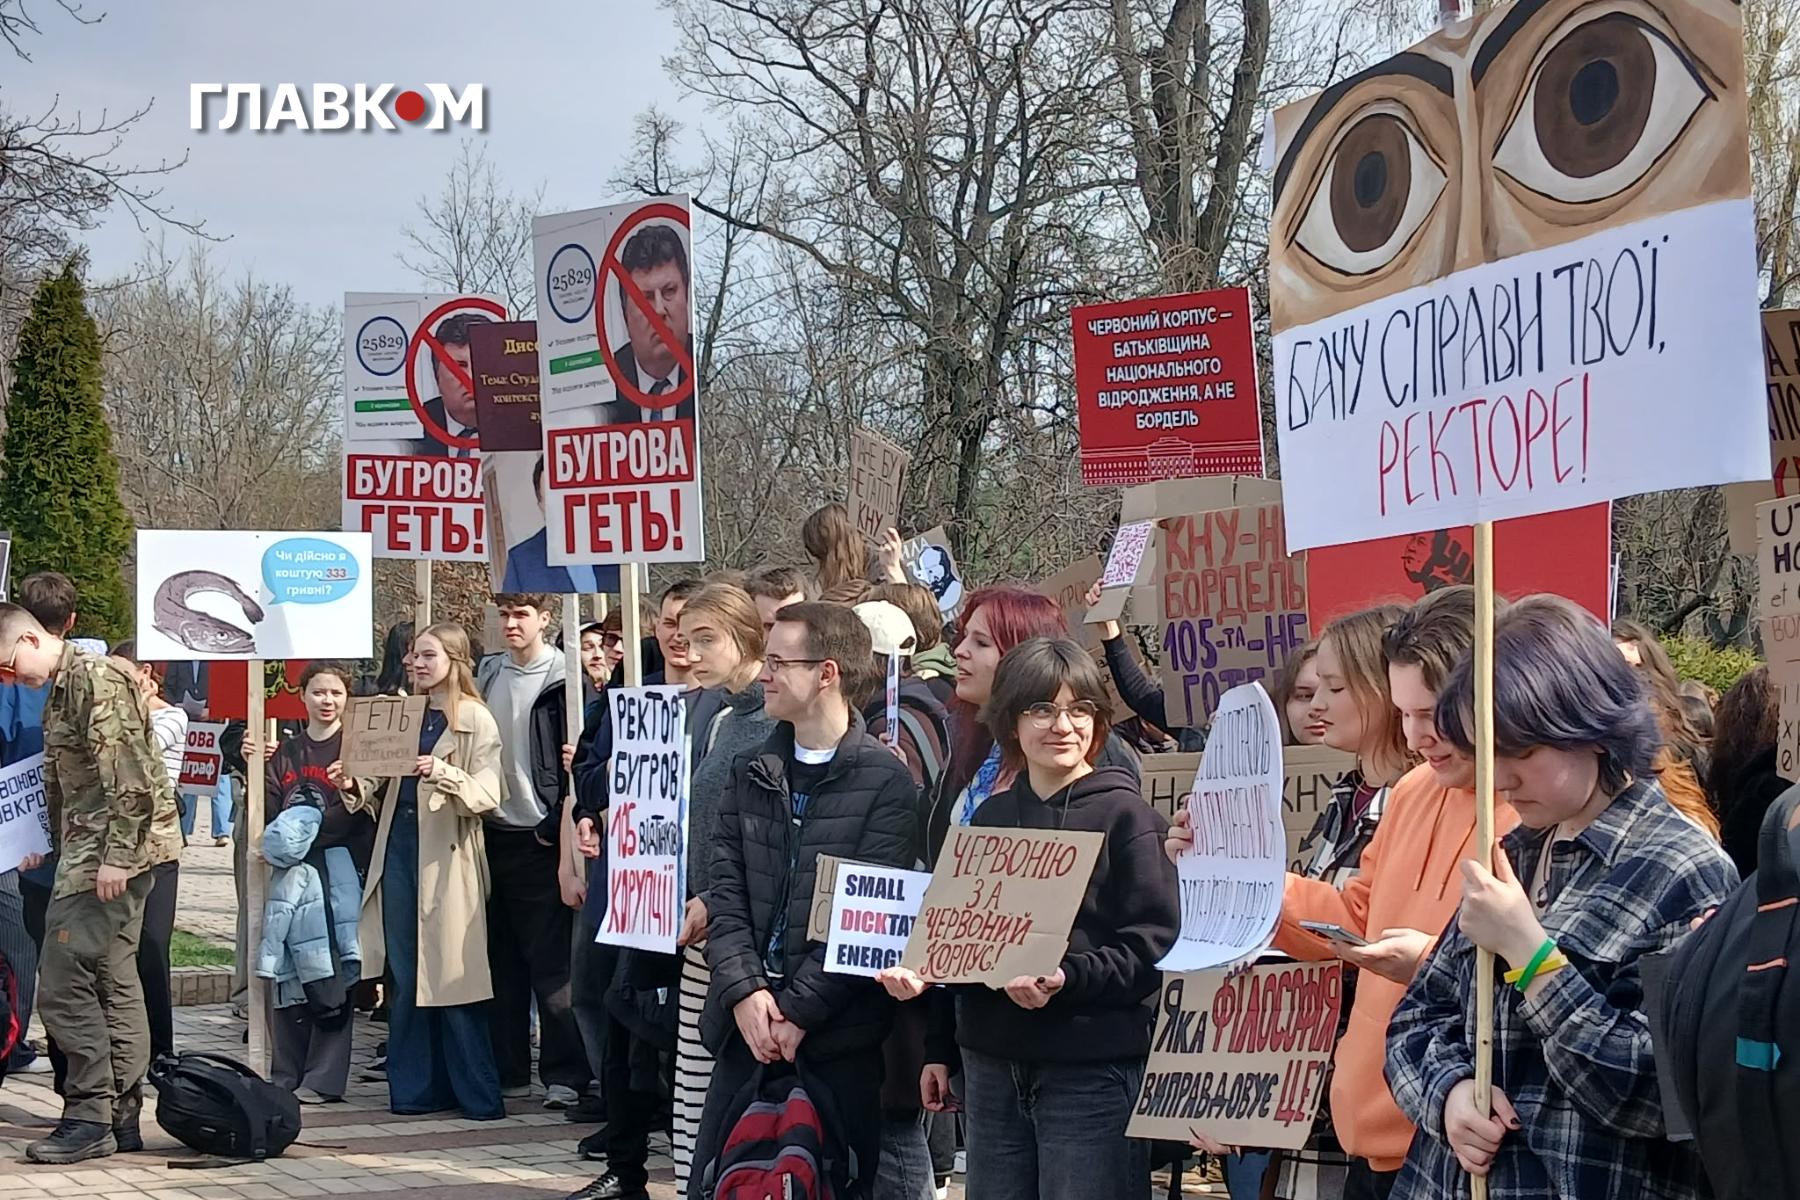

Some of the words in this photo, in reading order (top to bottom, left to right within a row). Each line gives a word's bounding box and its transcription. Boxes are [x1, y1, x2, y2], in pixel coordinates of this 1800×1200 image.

[552, 268, 592, 292] 25829
[1087, 310, 1160, 335] ЧЕРВОНИЙ
[1162, 306, 1217, 328] КОРПУС
[362, 334, 404, 352] 25829
[1113, 333, 1210, 358] БАТЬКІВЩИНА
[1288, 319, 1370, 431] БАЧУ
[1380, 271, 1543, 408] СПРАВИ
[1105, 357, 1221, 383] НАЦІОНАЛЬНОГО
[1097, 384, 1203, 409] ВІДРОДЖЕННЯ,
[1203, 384, 1214, 400] А
[1215, 382, 1236, 399] НЕ
[1135, 409, 1200, 430] БОРДЕЛЬ
[555, 427, 689, 482] БУГРОВА
[1379, 372, 1591, 517] РЕКТОРЕ!
[361, 504, 484, 554] ГЕТЬ!
[564, 488, 683, 554] ГЕТЬ!
[856, 500, 884, 538] КНУ
[275, 550, 292, 561] Чи
[294, 550, 336, 563] дійсно
[338, 552, 347, 561] я
[275, 569, 323, 580] коштую
[326, 568, 347, 578] 333
[286, 585, 332, 597] гривні?
[1164, 561, 1306, 625] БОРДЕЛЬ
[351, 700, 410, 732] ГЕТЬ
[616, 691, 680, 744] РЕКТОР
[614, 750, 679, 802] БУГРОВ
[611, 801, 637, 859] 105
[952, 832, 1077, 879] ЧЕРВОНІЮ
[607, 864, 676, 937] КОРУПЦІЇ
[845, 874, 905, 901] SMALL
[966, 878, 1002, 910] ЗА
[925, 906, 1034, 945] ЧЕРВОНИЙ
[920, 940, 1006, 979] КОРПУС!
[1211, 965, 1340, 1054] ФІЛОСОФІЯ
[1273, 1059, 1326, 1127] ЦЕ?
